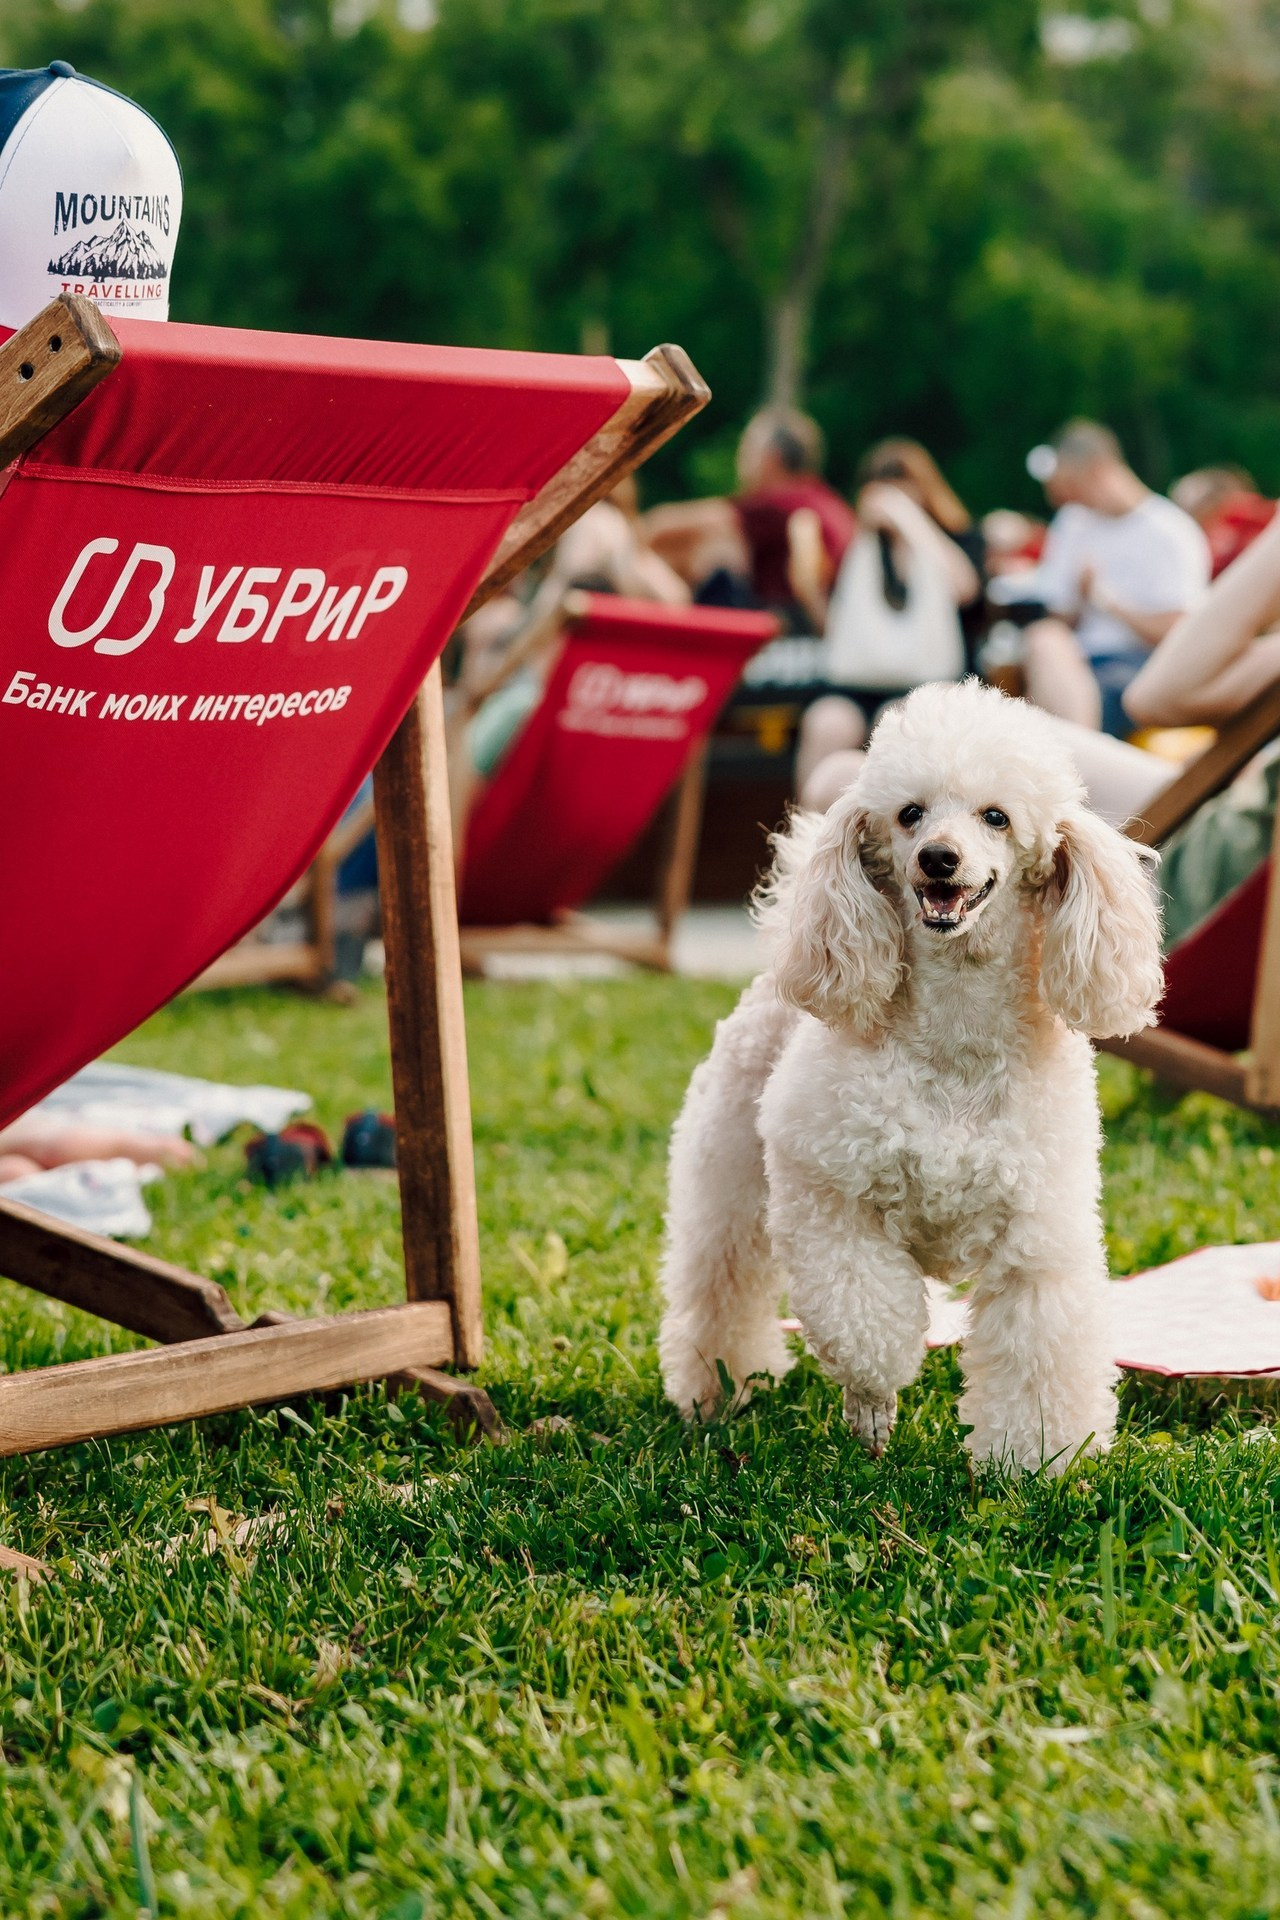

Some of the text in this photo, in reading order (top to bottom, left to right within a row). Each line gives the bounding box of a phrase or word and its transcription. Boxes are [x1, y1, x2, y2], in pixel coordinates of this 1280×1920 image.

[54, 191, 170, 237] MOUNTAINS
[61, 282, 162, 299] TRAVELLING
[173, 565, 409, 644] УБРиР
[1, 670, 353, 727] Банк моих интересов
